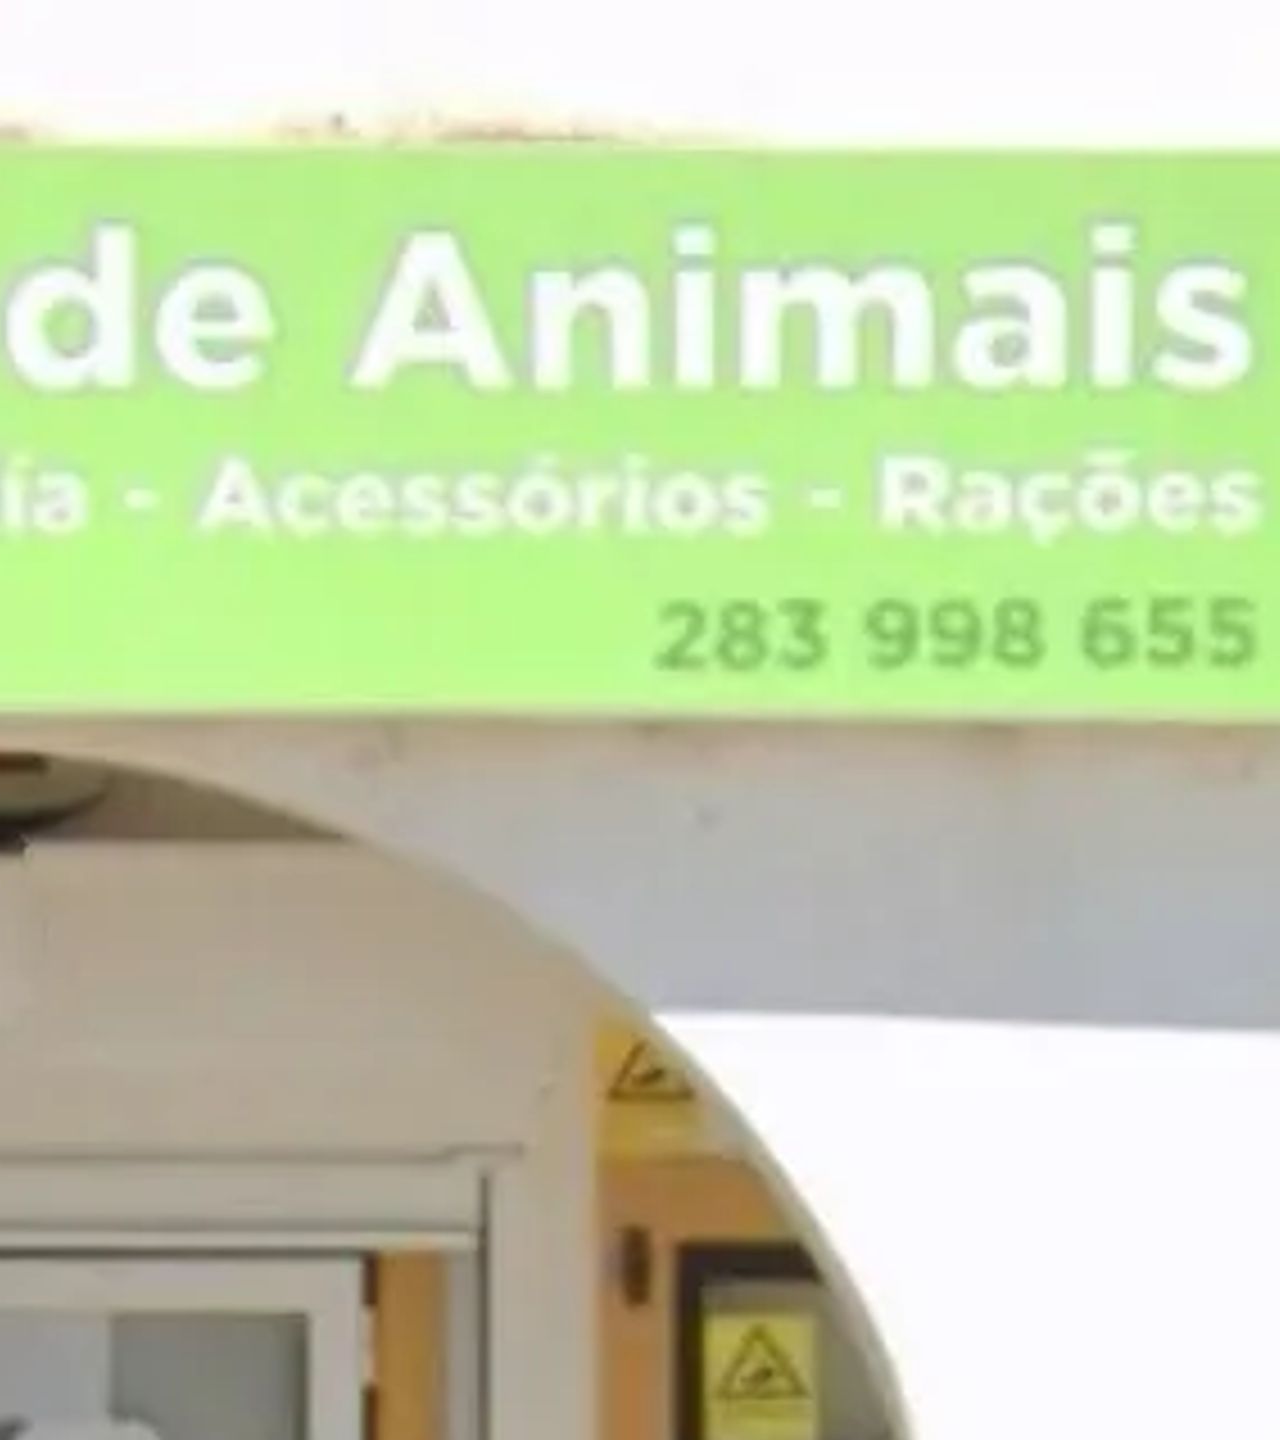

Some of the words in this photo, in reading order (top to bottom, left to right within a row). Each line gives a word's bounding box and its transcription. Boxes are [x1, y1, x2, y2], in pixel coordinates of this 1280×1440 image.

[3, 222, 276, 392] de
[349, 222, 1256, 394] Animais
[193, 450, 773, 537] Acessórios
[875, 447, 1262, 546] Rações
[654, 597, 826, 672] 283
[862, 597, 1046, 671] 998
[1079, 595, 1258, 669] 655
